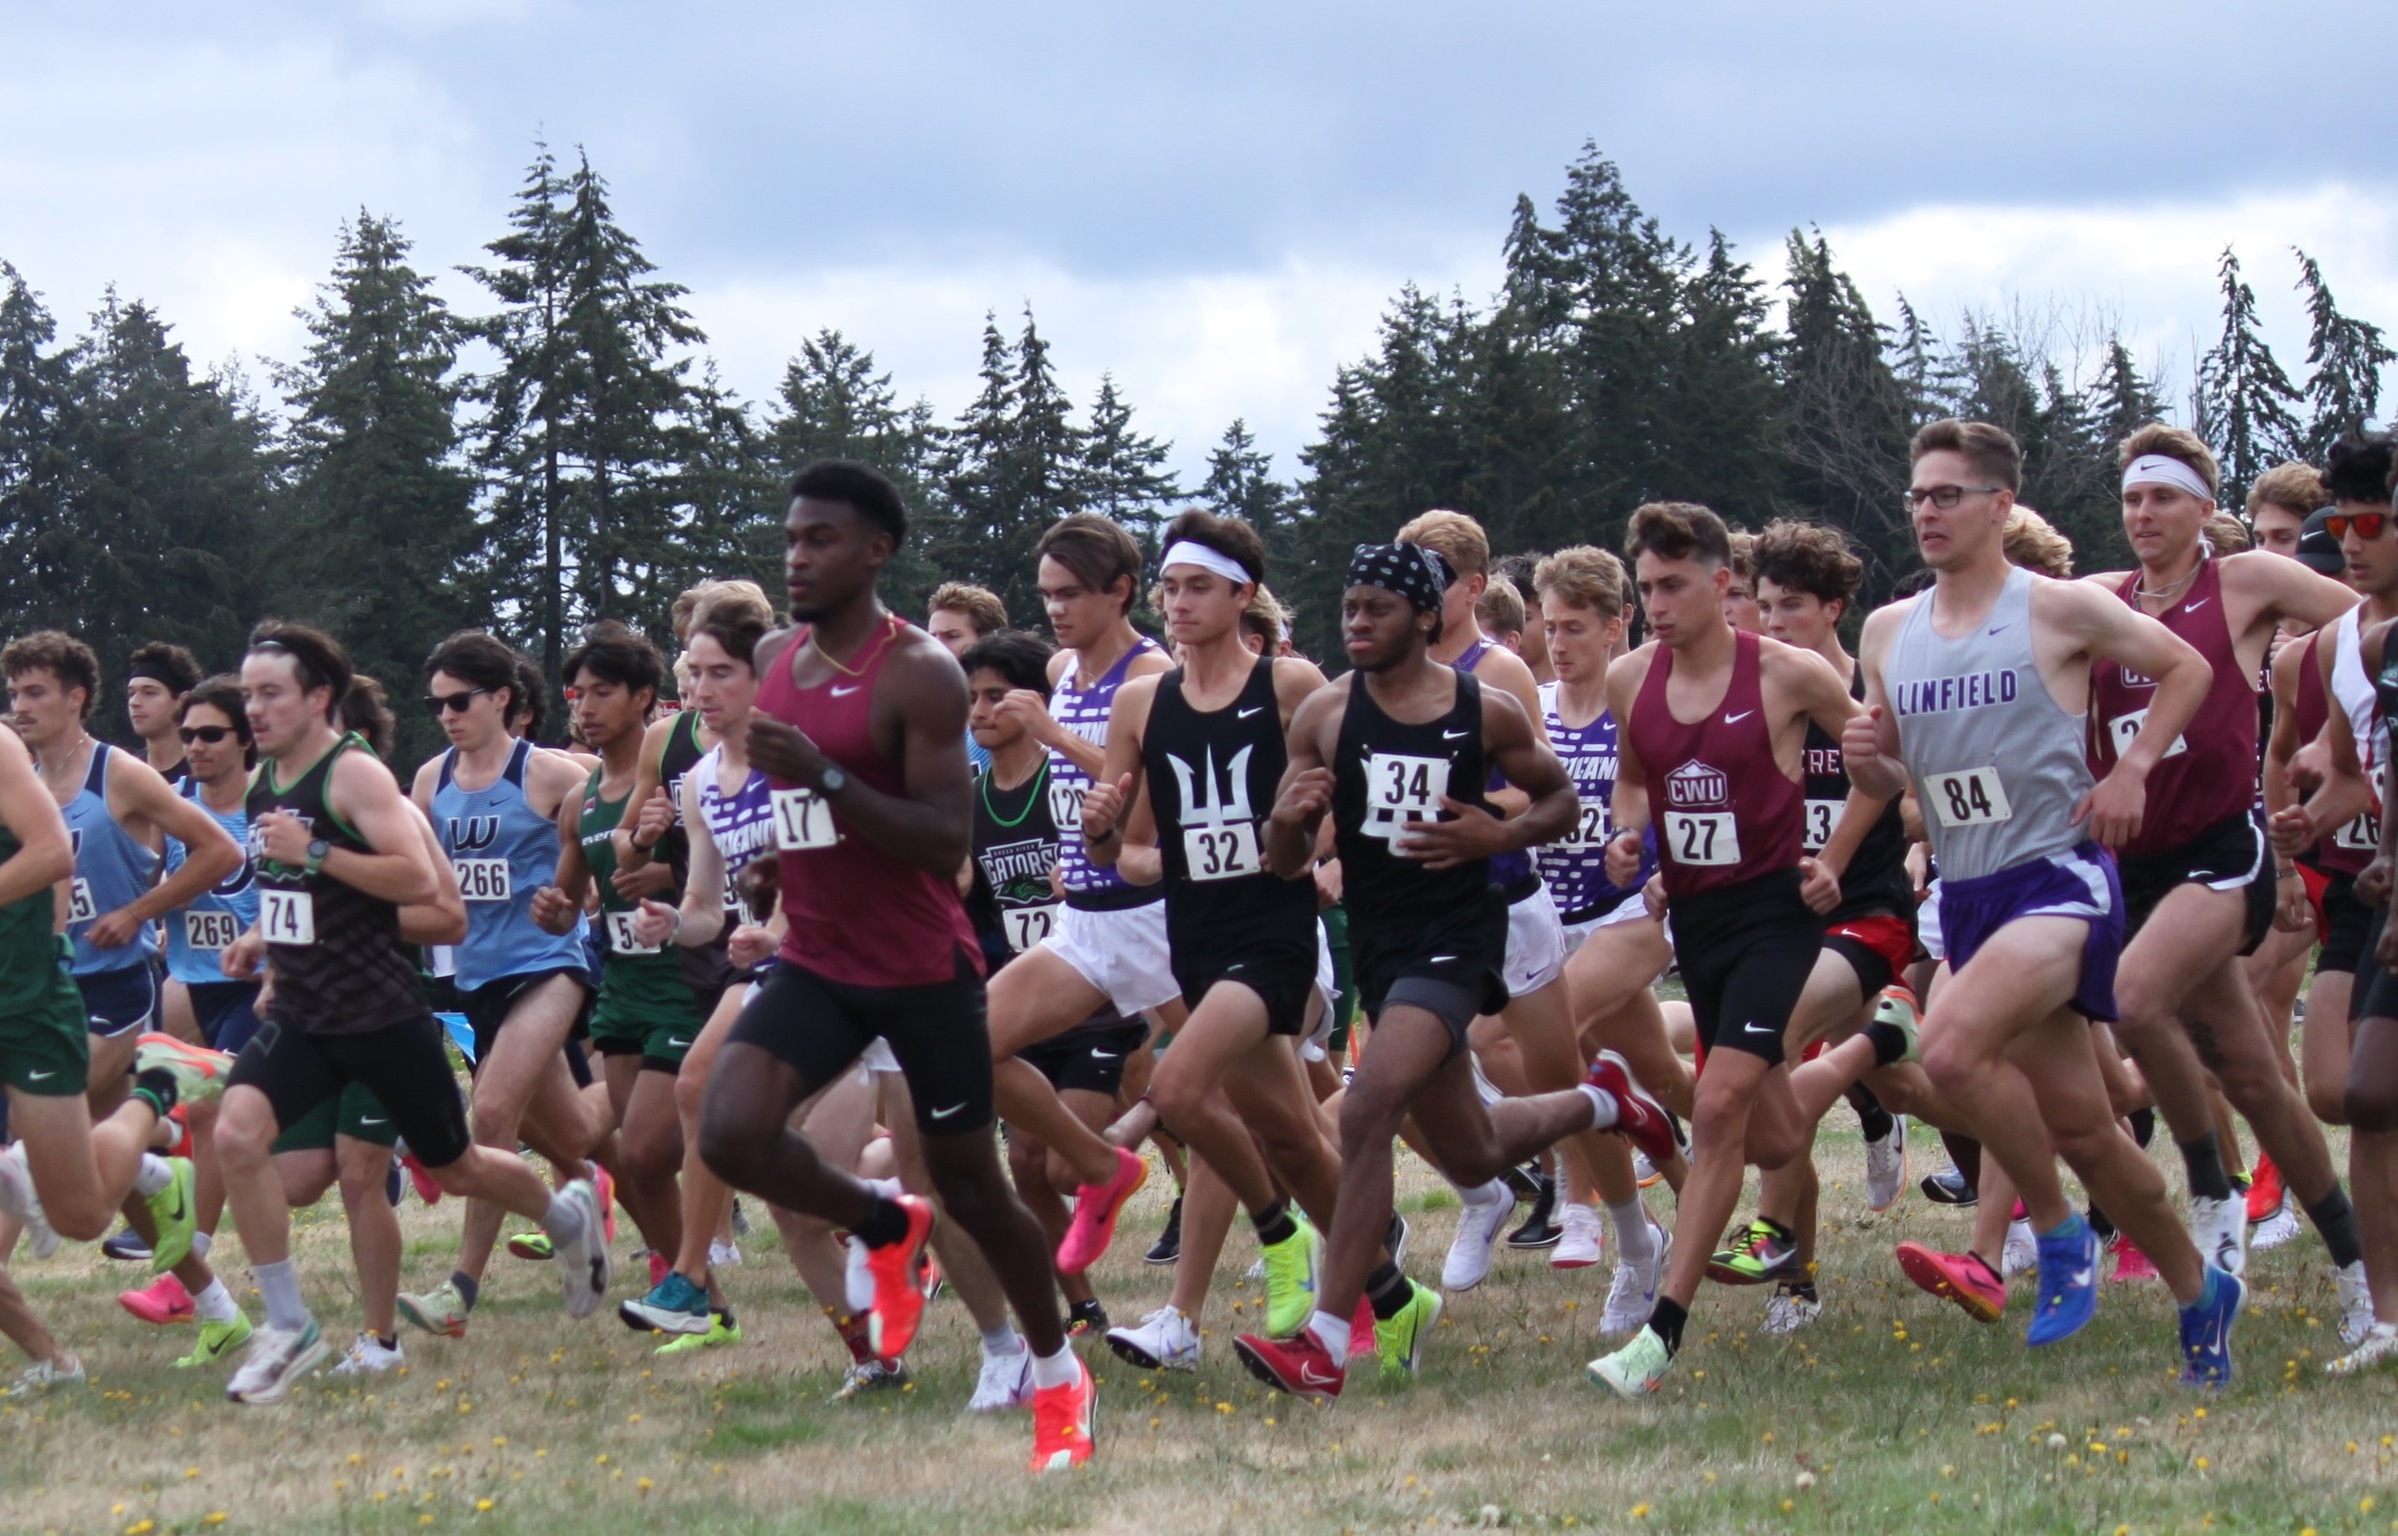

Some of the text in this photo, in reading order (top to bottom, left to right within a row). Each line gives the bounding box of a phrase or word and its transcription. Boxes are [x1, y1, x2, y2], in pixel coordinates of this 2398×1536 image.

[1897, 668, 2018, 716] LINFIELD
[1385, 760, 1430, 806] 34
[1669, 777, 1723, 802] CWU
[1943, 774, 1992, 821] 84
[448, 815, 500, 852] W
[780, 797, 811, 844] 17
[1678, 818, 1718, 860] 27
[984, 848, 1057, 886] GATORS
[1198, 830, 1245, 875] 32
[457, 862, 506, 897] 266
[188, 914, 236, 946] 269
[269, 896, 298, 938] 74
[1015, 910, 1052, 948] 72
